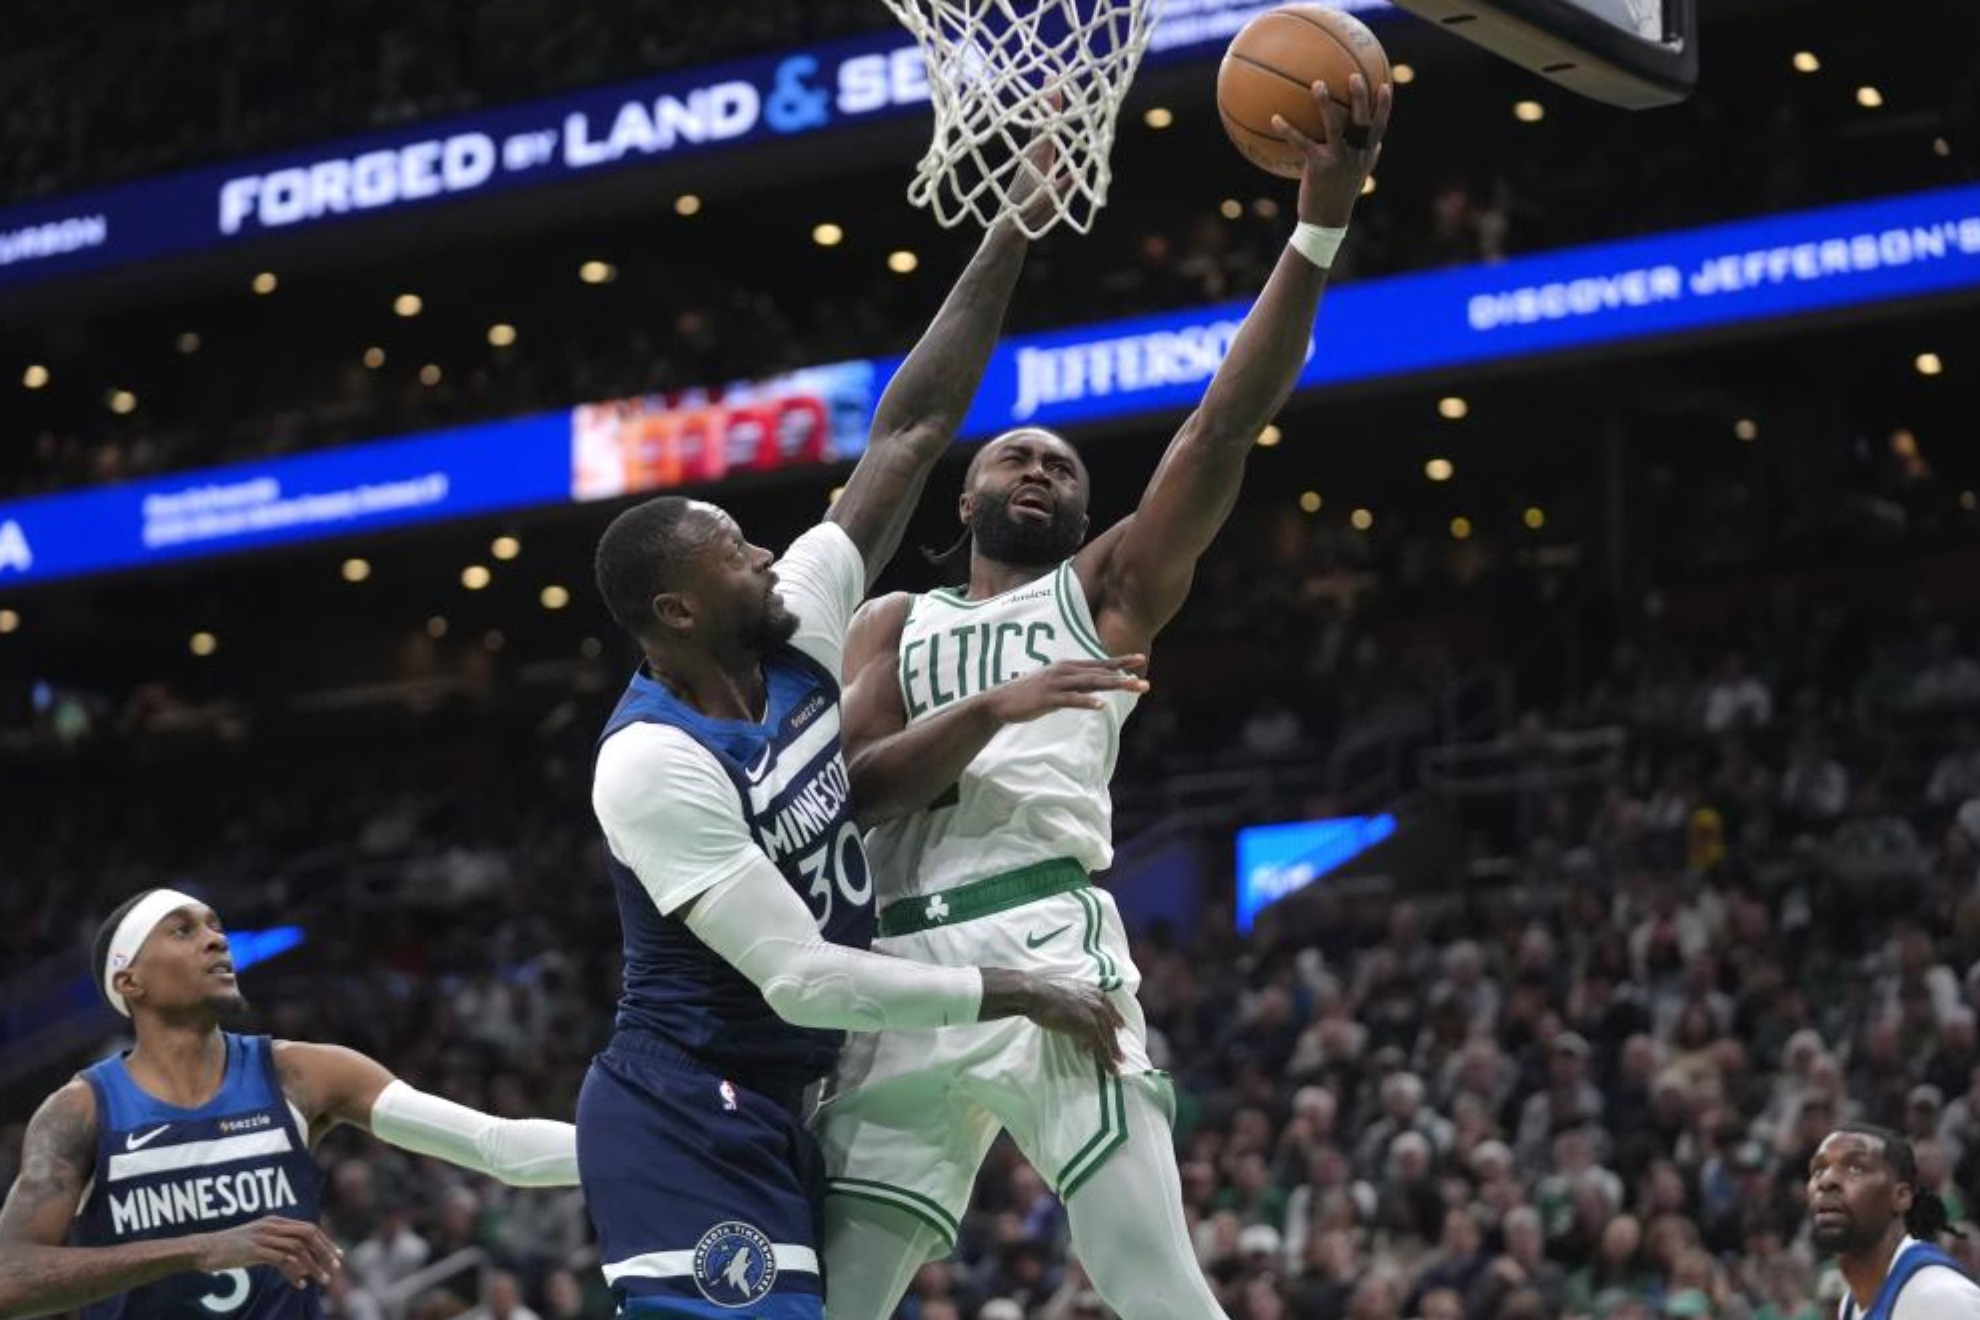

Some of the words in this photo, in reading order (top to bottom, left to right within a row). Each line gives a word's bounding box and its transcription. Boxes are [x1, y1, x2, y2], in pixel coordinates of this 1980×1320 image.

[219, 133, 496, 234] FORGED
[503, 130, 557, 170] BY
[564, 81, 760, 167] LAND
[766, 56, 827, 132] &
[1469, 266, 1681, 330] DISCOVER
[902, 620, 1055, 721] ELTICS
[759, 750, 850, 863] MINNESOT
[798, 821, 873, 933] 30
[108, 1165, 297, 1235] MINNESOTA
